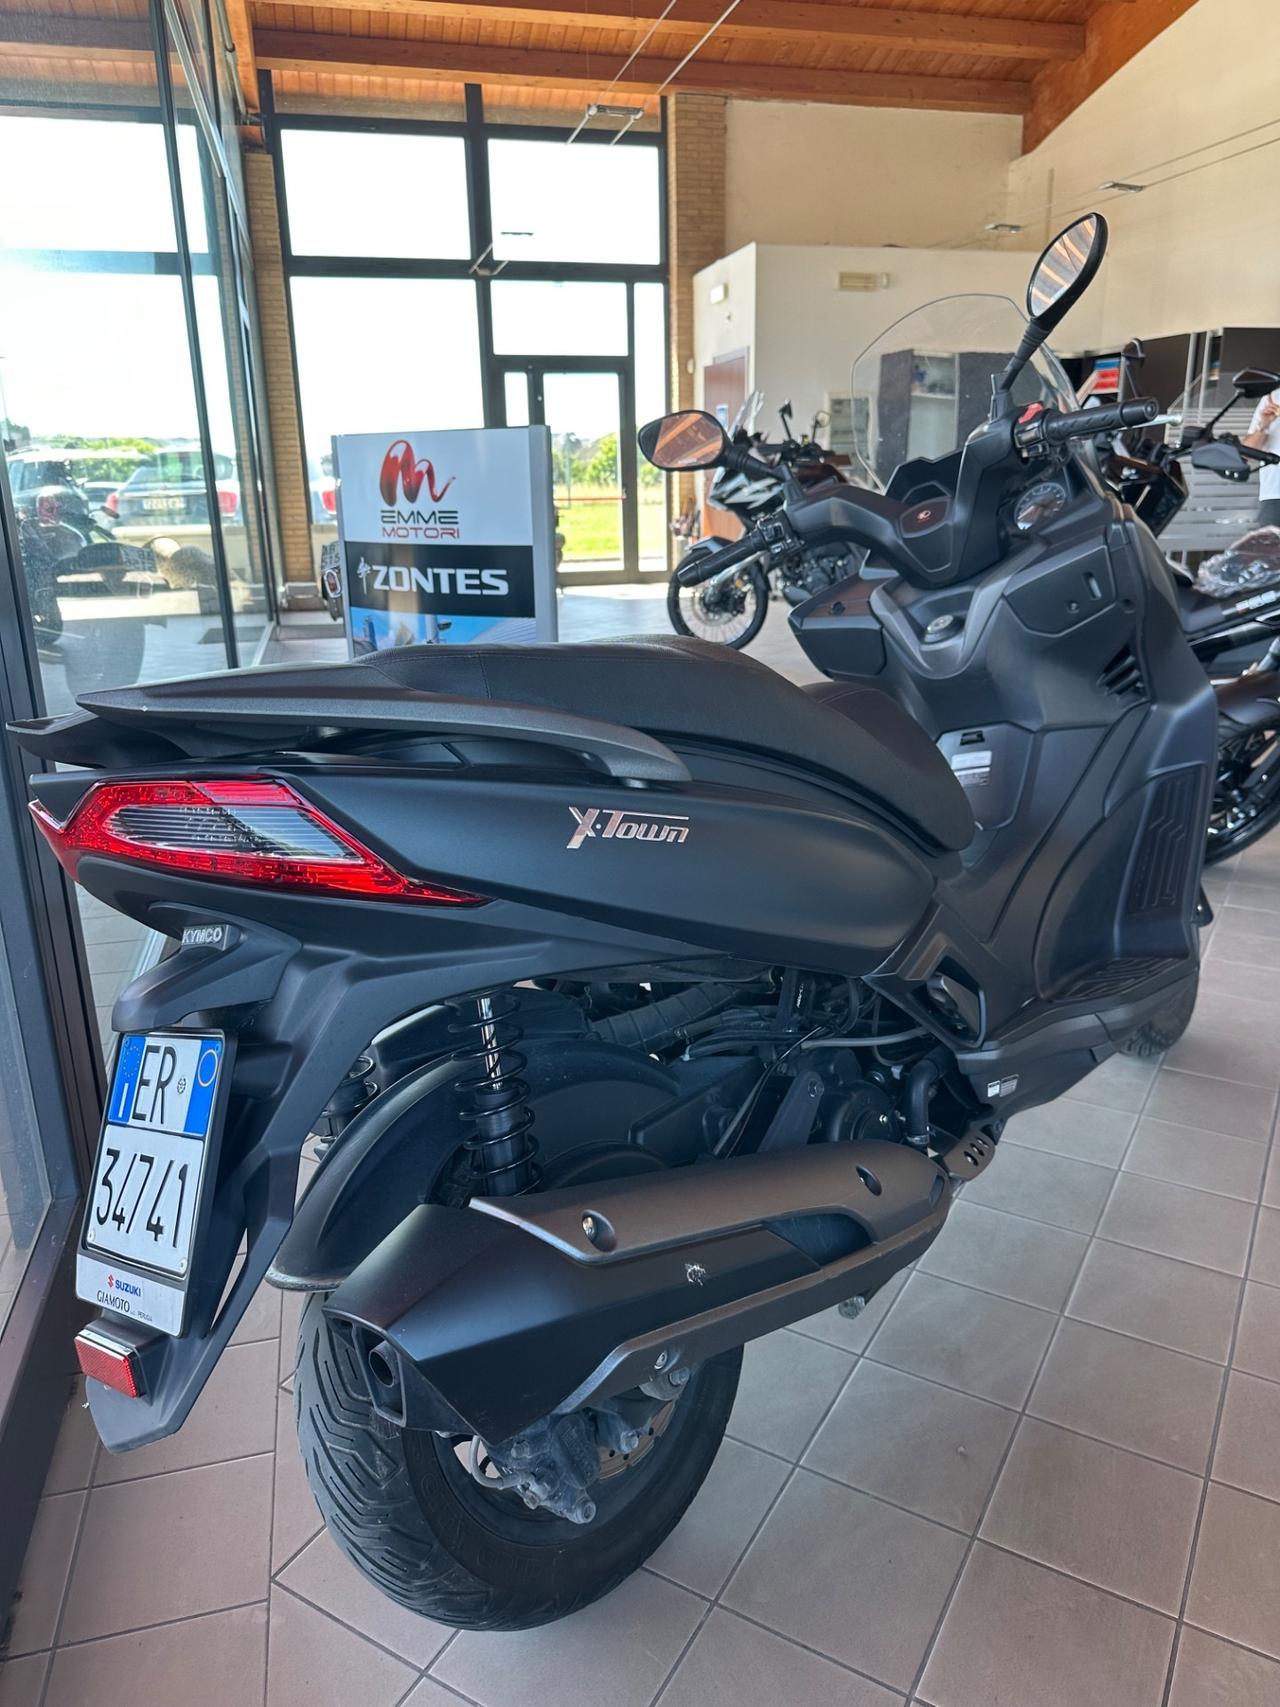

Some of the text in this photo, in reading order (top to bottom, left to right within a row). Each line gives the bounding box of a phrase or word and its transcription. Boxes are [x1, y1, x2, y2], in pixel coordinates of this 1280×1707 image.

[380, 510, 459, 525] EMME
[382, 527, 460, 540] MOTORI
[371, 564, 509, 596] ZONTES
[181, 927, 223, 944] KYMCO
[131, 1044, 178, 1125] ER
[96, 1147, 189, 1249] 34741
[115, 1279, 142, 1297] SUZUKI
[96, 1289, 130, 1313] GIAMOTO
